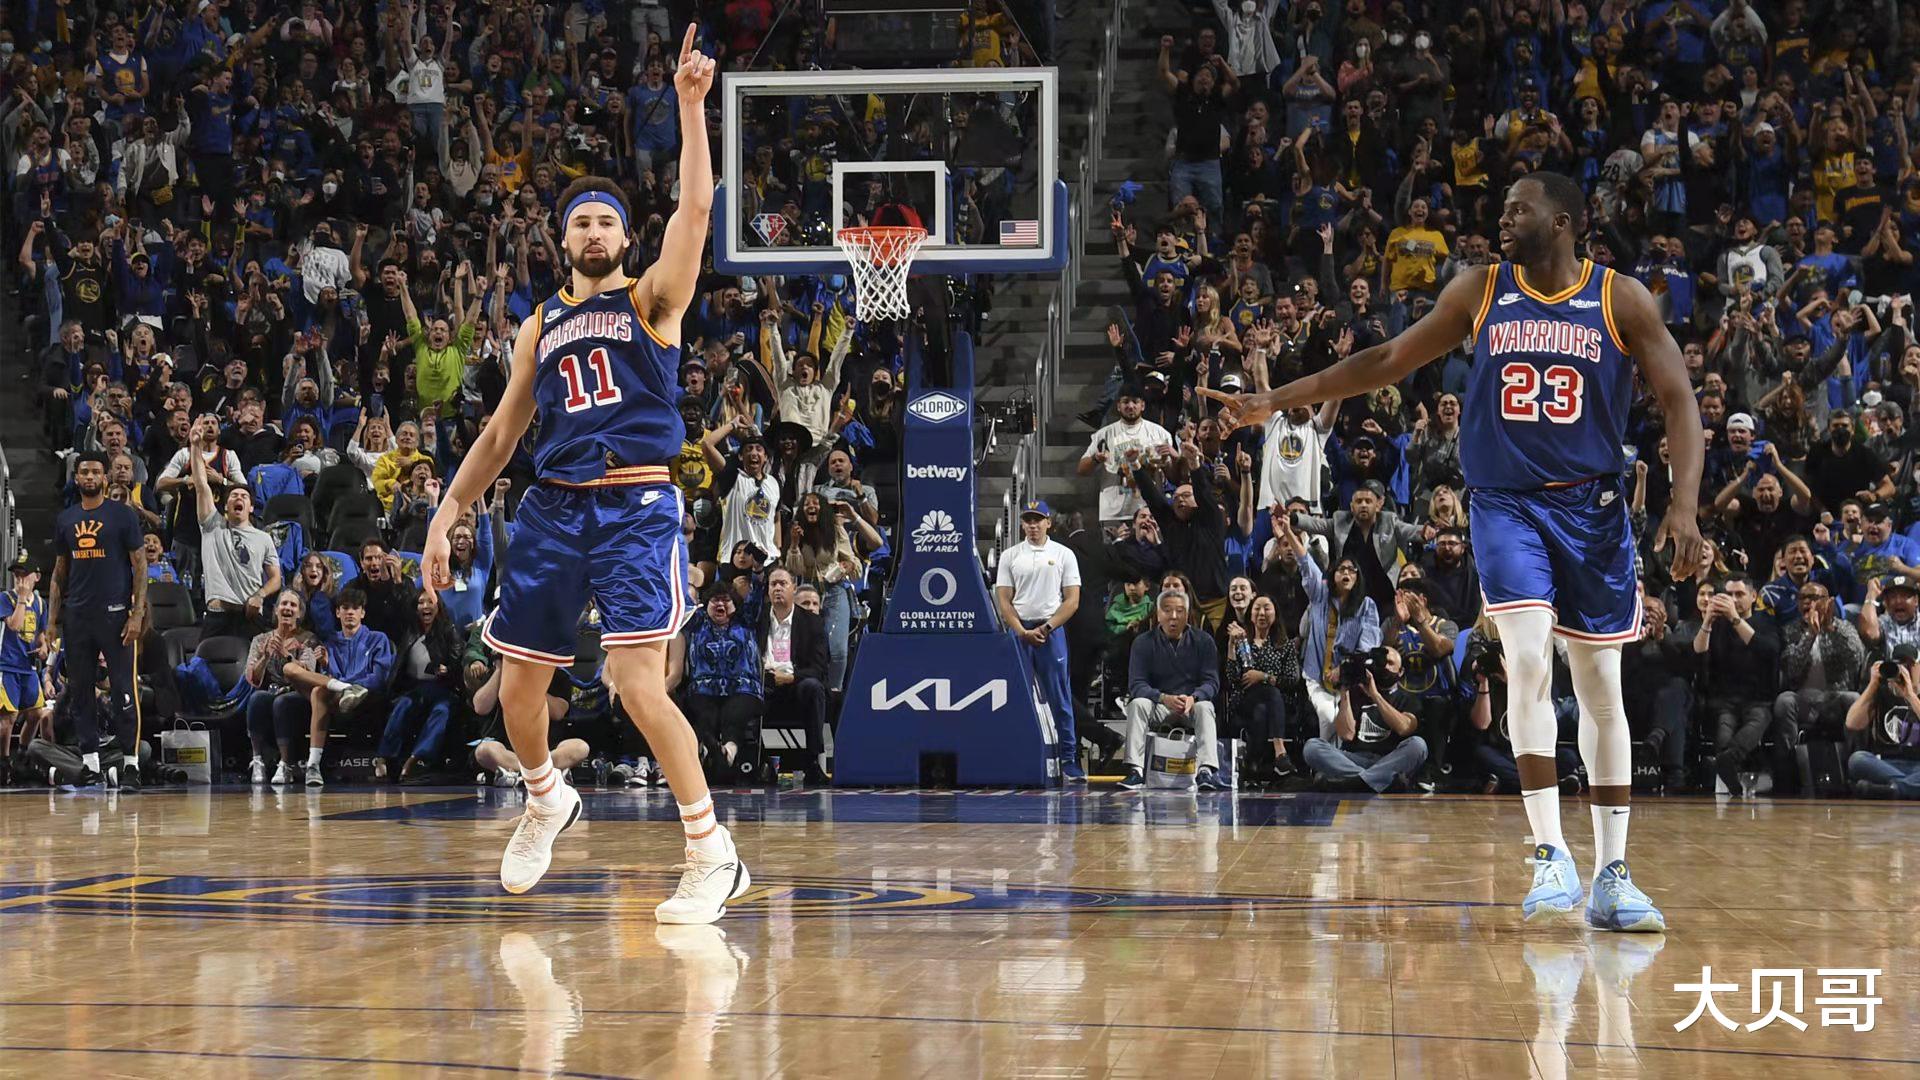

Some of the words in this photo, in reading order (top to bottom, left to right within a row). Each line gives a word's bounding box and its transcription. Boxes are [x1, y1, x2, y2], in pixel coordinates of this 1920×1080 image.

[541, 311, 632, 363] WARRIORS
[1489, 319, 1602, 363] WARRIORS
[558, 347, 623, 413] 11
[1501, 362, 1584, 424] 23
[915, 400, 959, 414] CLOROX
[907, 464, 968, 482] betway
[74, 520, 103, 538] JAZZ
[911, 529, 963, 546] Sports
[899, 611, 975, 620] GLOBALIZATION
[901, 620, 974, 629] PARTNERS
[871, 678, 1007, 711] KIA
